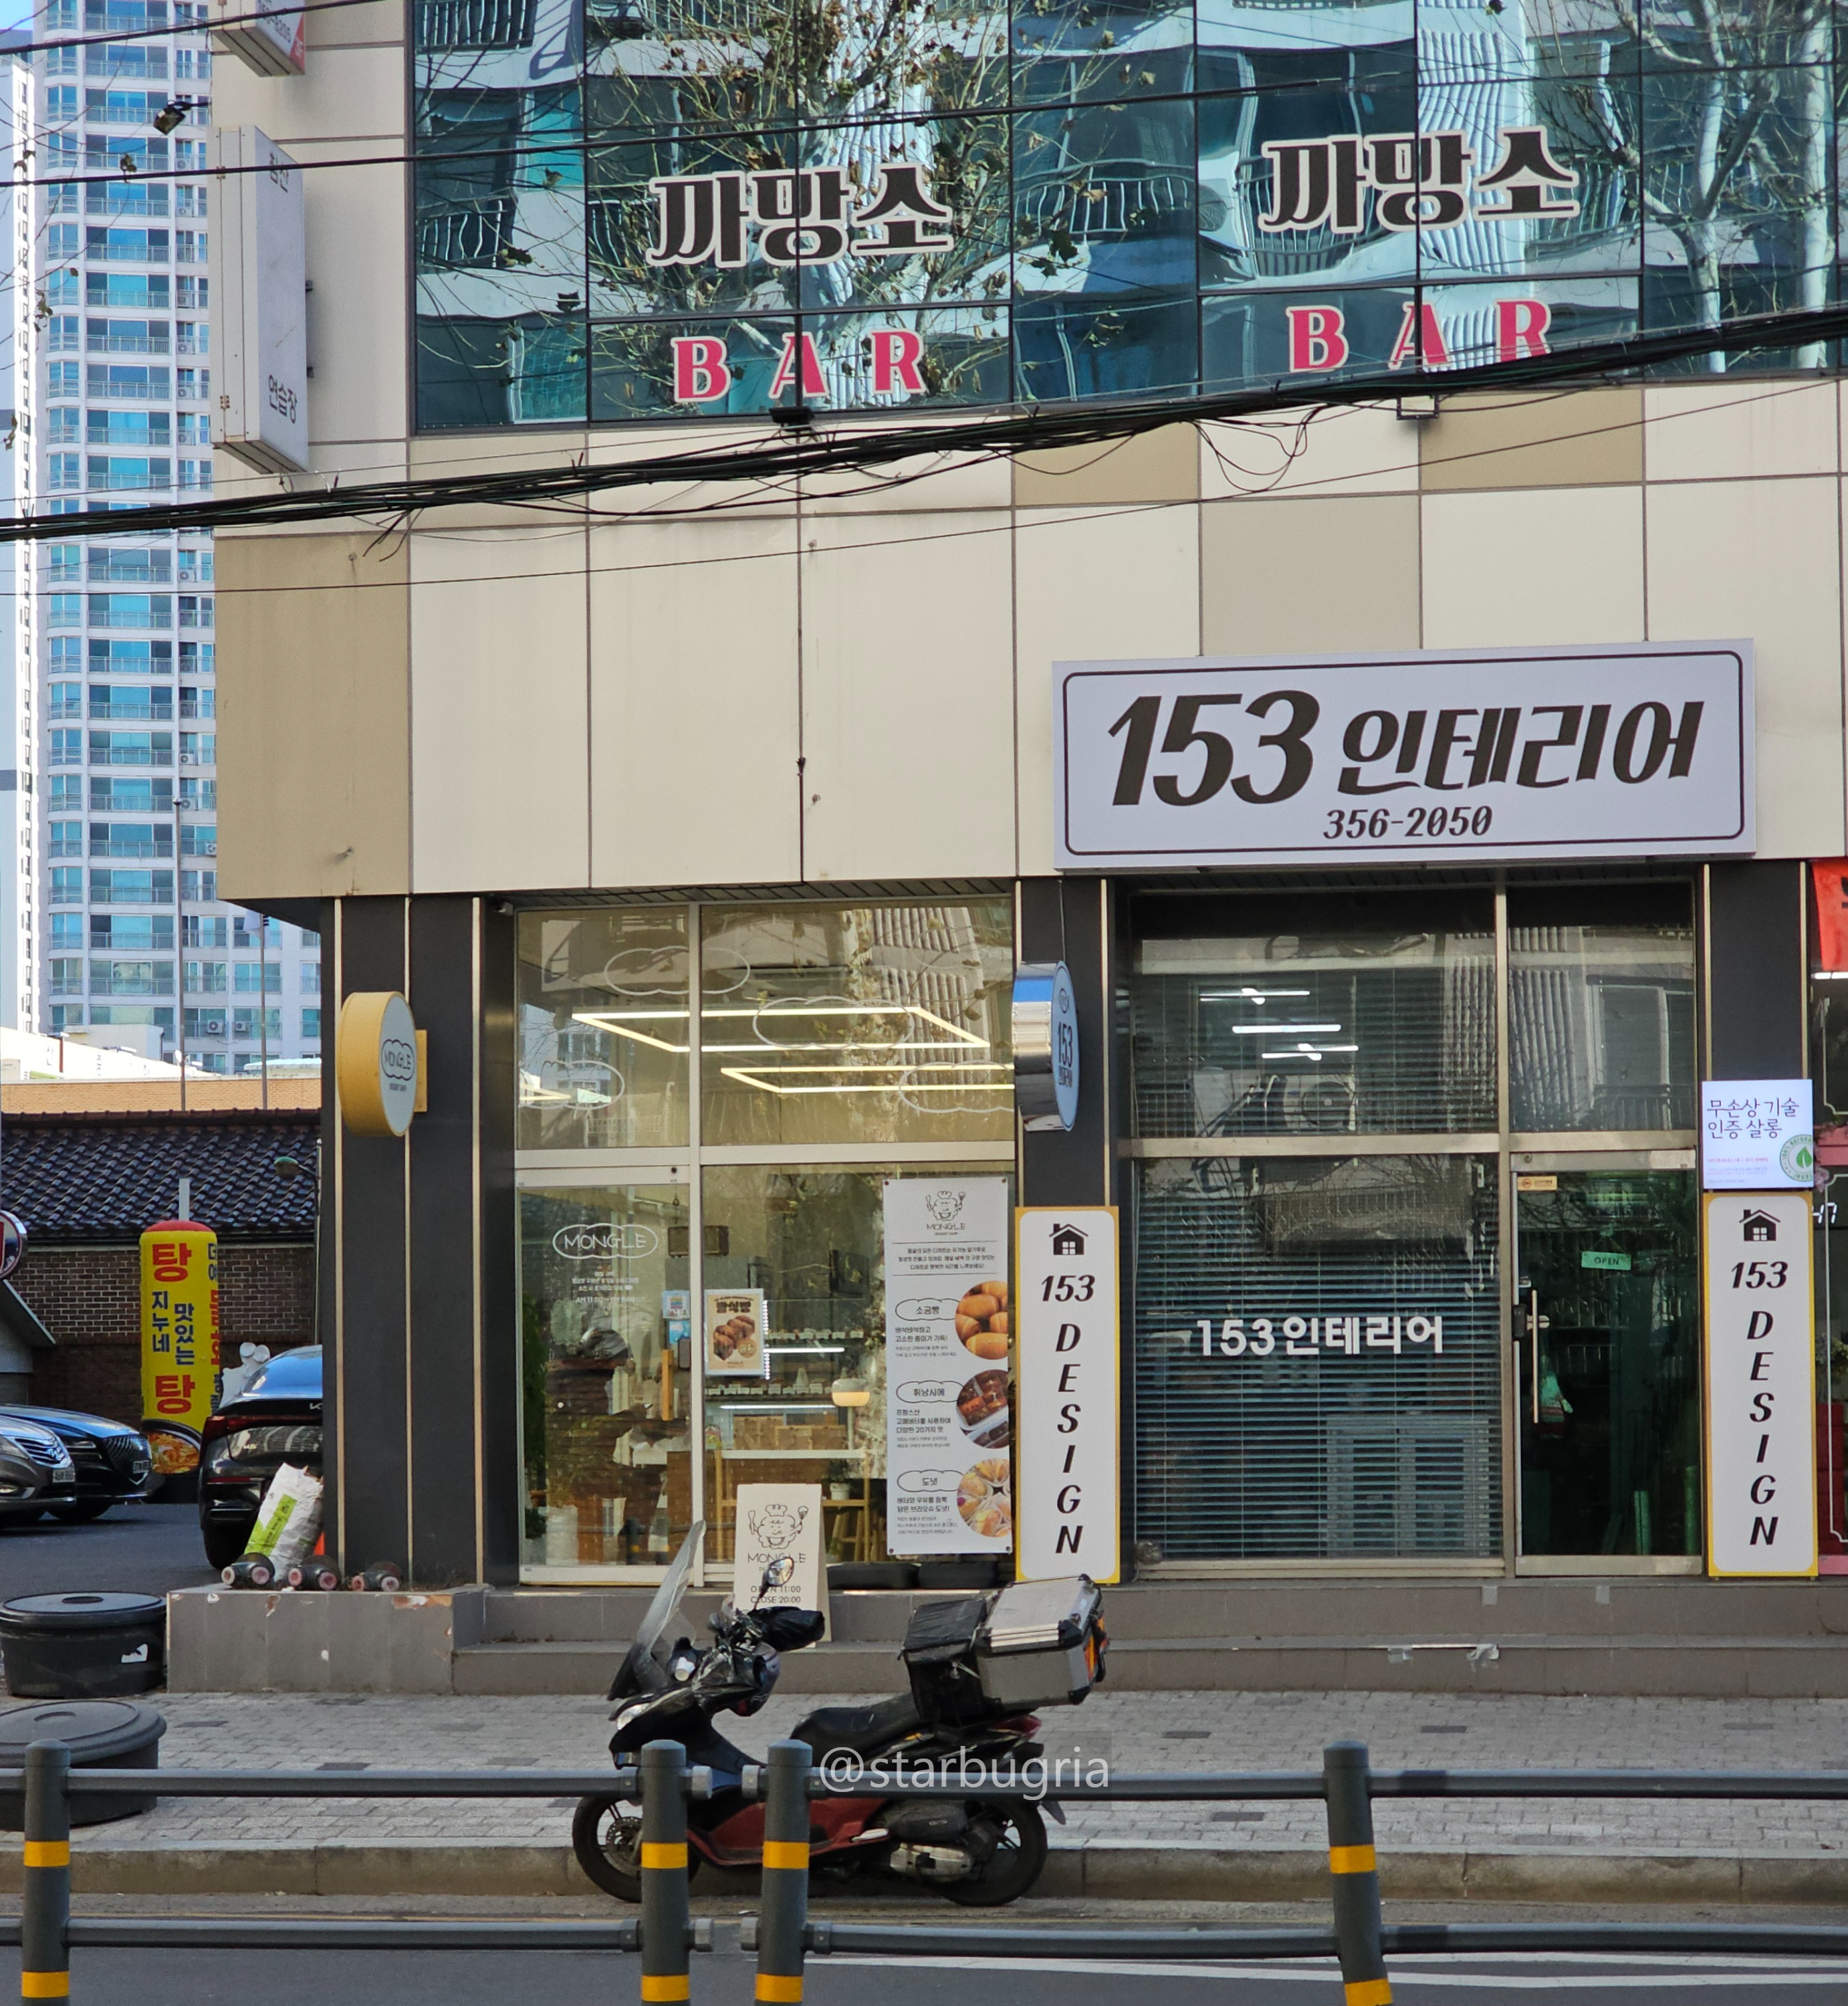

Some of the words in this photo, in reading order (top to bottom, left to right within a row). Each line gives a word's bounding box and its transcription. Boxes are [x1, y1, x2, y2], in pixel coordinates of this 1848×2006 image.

[1260, 126, 1579, 233] 까망소
[646, 162, 953, 268] 까망소
[1286, 298, 1551, 372] BAR
[671, 328, 926, 403] BAR
[269, 374, 297, 424] 연습장
[1107, 690, 1320, 806] 153
[1337, 701, 1705, 795] 인테리어
[1322, 805, 1493, 840] 356-2050
[1058, 1022, 1072, 1068] 153
[1707, 1098, 1760, 1118] 무손상
[1764, 1097, 1799, 1117] 기술
[1708, 1119, 1742, 1139] 인증
[1746, 1119, 1782, 1139] 살롱
[564, 1233, 647, 1250] MONGLE
[927, 1222, 966, 1230] MONGLE
[152, 1242, 193, 1283] 탕
[1595, 1257, 1619, 1266] OPEN
[1731, 1260, 1788, 1289] 153
[1042, 1274, 1096, 1302] 153
[151, 1291, 170, 1353] 지누네
[916, 1306, 940, 1315] 소금빵
[174, 1303, 195, 1365] 맛있는
[154, 1374, 196, 1415] 탕
[913, 1388, 945, 1397] 휘낭시에
[1055, 1323, 1083, 1554] DESIGN
[1746, 1311, 1779, 1545] DESIGN
[922, 1477, 938, 1486] 도넛
[779, 1595, 801, 1603] 20:00
